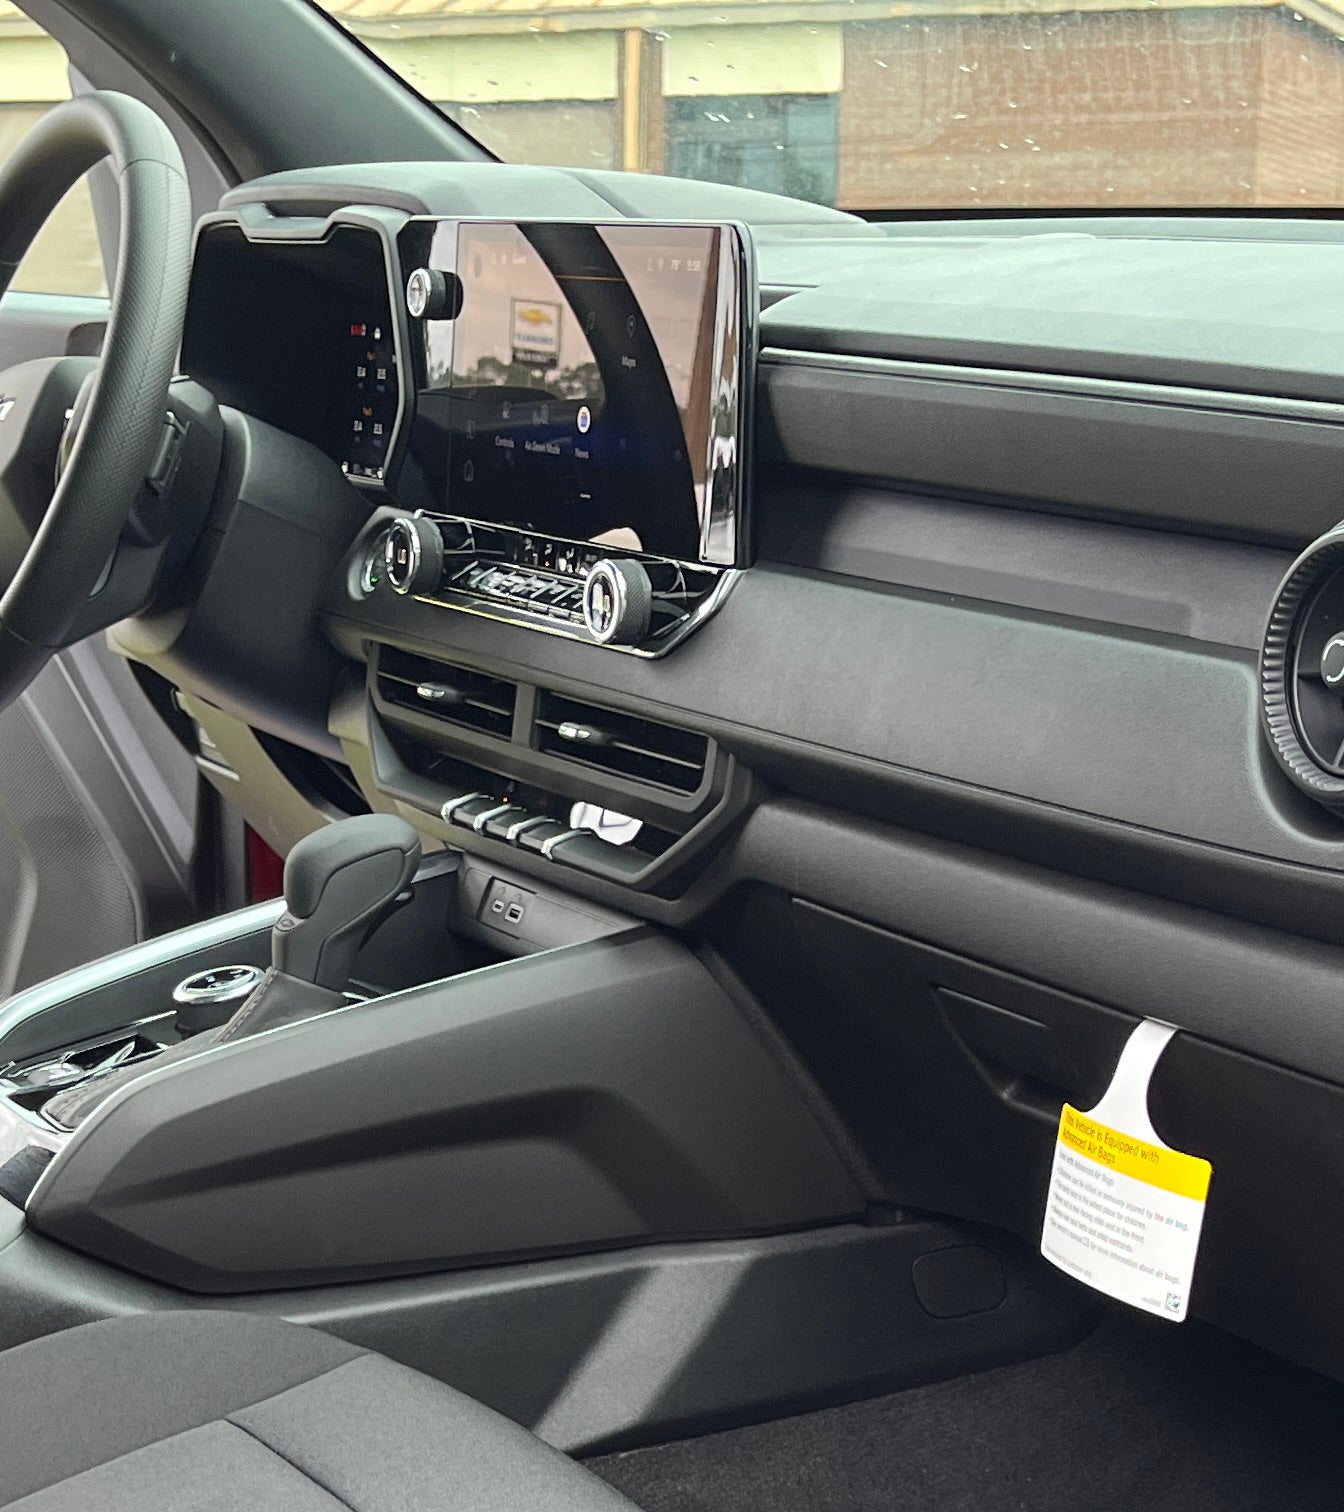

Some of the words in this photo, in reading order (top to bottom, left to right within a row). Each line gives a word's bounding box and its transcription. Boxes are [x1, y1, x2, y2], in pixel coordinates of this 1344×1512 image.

[1098, 1146, 1116, 1164] Bags
[1104, 1133, 1139, 1156] Equipped
[1141, 1149, 1159, 1164] with
